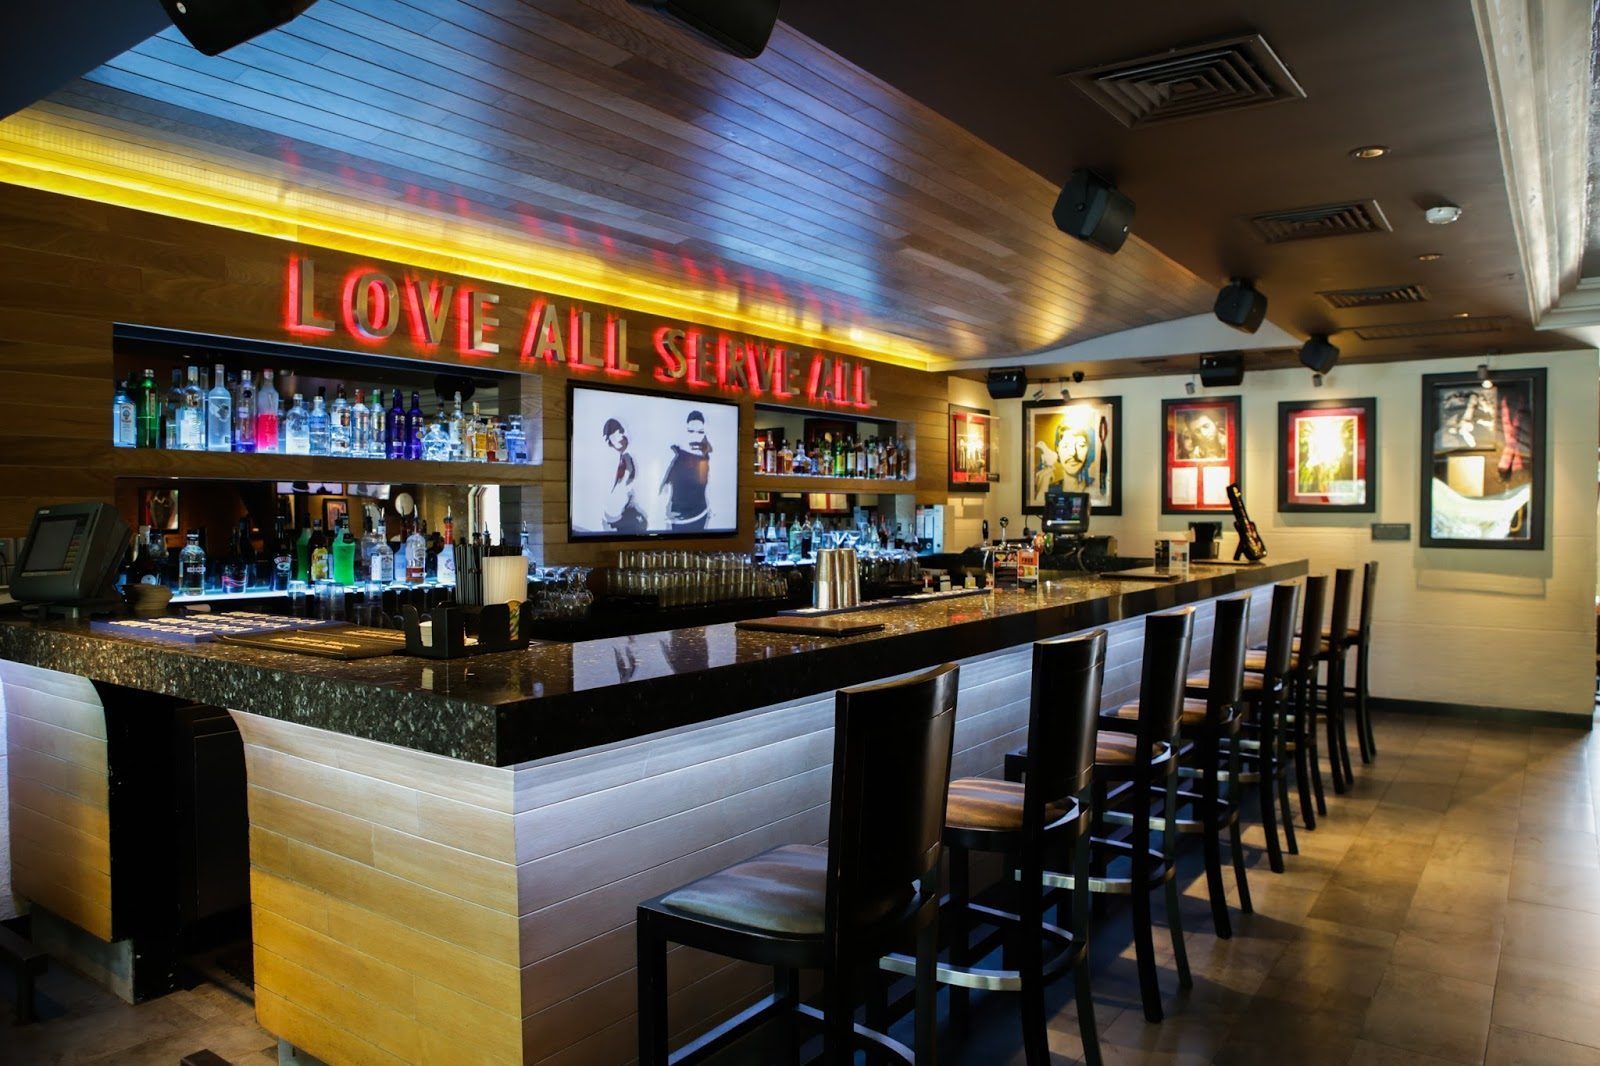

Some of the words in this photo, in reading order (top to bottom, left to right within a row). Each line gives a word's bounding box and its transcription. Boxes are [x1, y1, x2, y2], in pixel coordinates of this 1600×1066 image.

[286, 256, 501, 355] LOVE
[523, 301, 640, 377] ALL
[656, 326, 801, 399] SERVE
[808, 354, 877, 409] ALL
